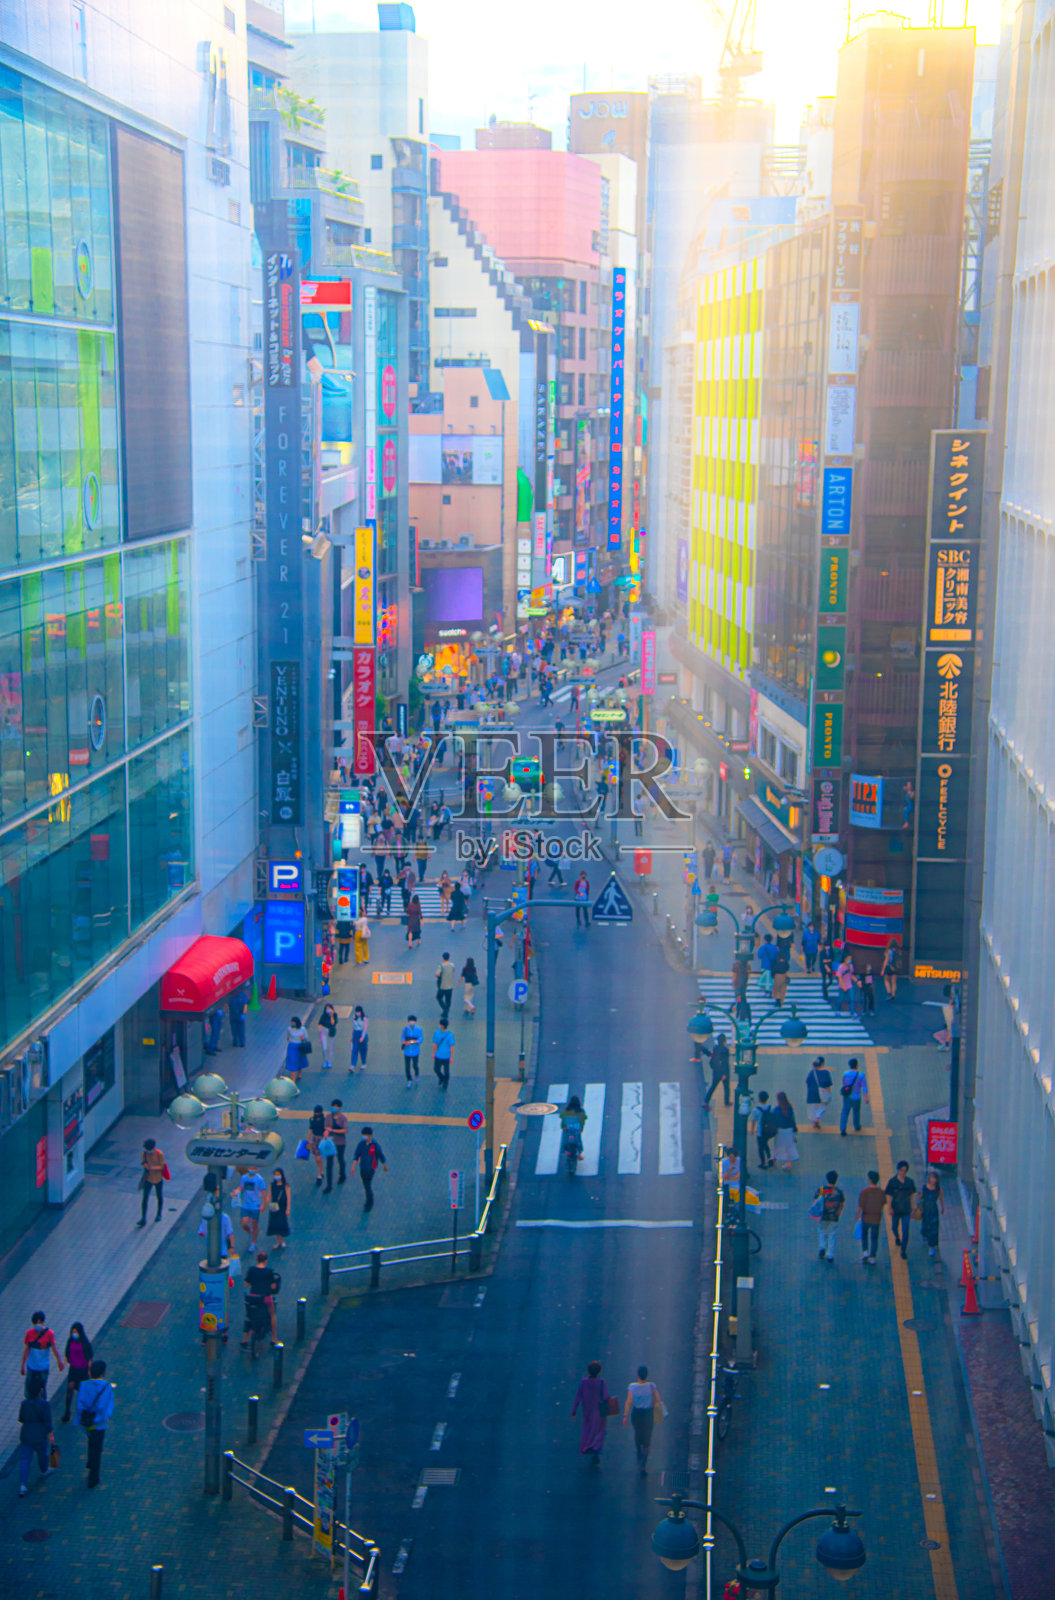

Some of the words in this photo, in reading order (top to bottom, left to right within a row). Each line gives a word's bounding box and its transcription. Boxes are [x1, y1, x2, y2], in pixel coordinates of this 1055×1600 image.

[278, 405, 289, 582] FOREVER
[827, 473, 846, 529] ARTON
[947, 439, 971, 533] シネクイント
[829, 556, 839, 605] PRONTO
[937, 549, 970, 564] SBC
[943, 568, 957, 624] クリニック
[954, 568, 970, 624] 湘南美容
[280, 602, 289, 645] 21
[357, 651, 372, 707] カラオケ
[824, 712, 833, 759] PRONTO
[937, 681, 959, 751] 北陸銀行
[273, 865, 299, 888] P
[274, 930, 297, 958] P
[514, 982, 528, 1002] P
